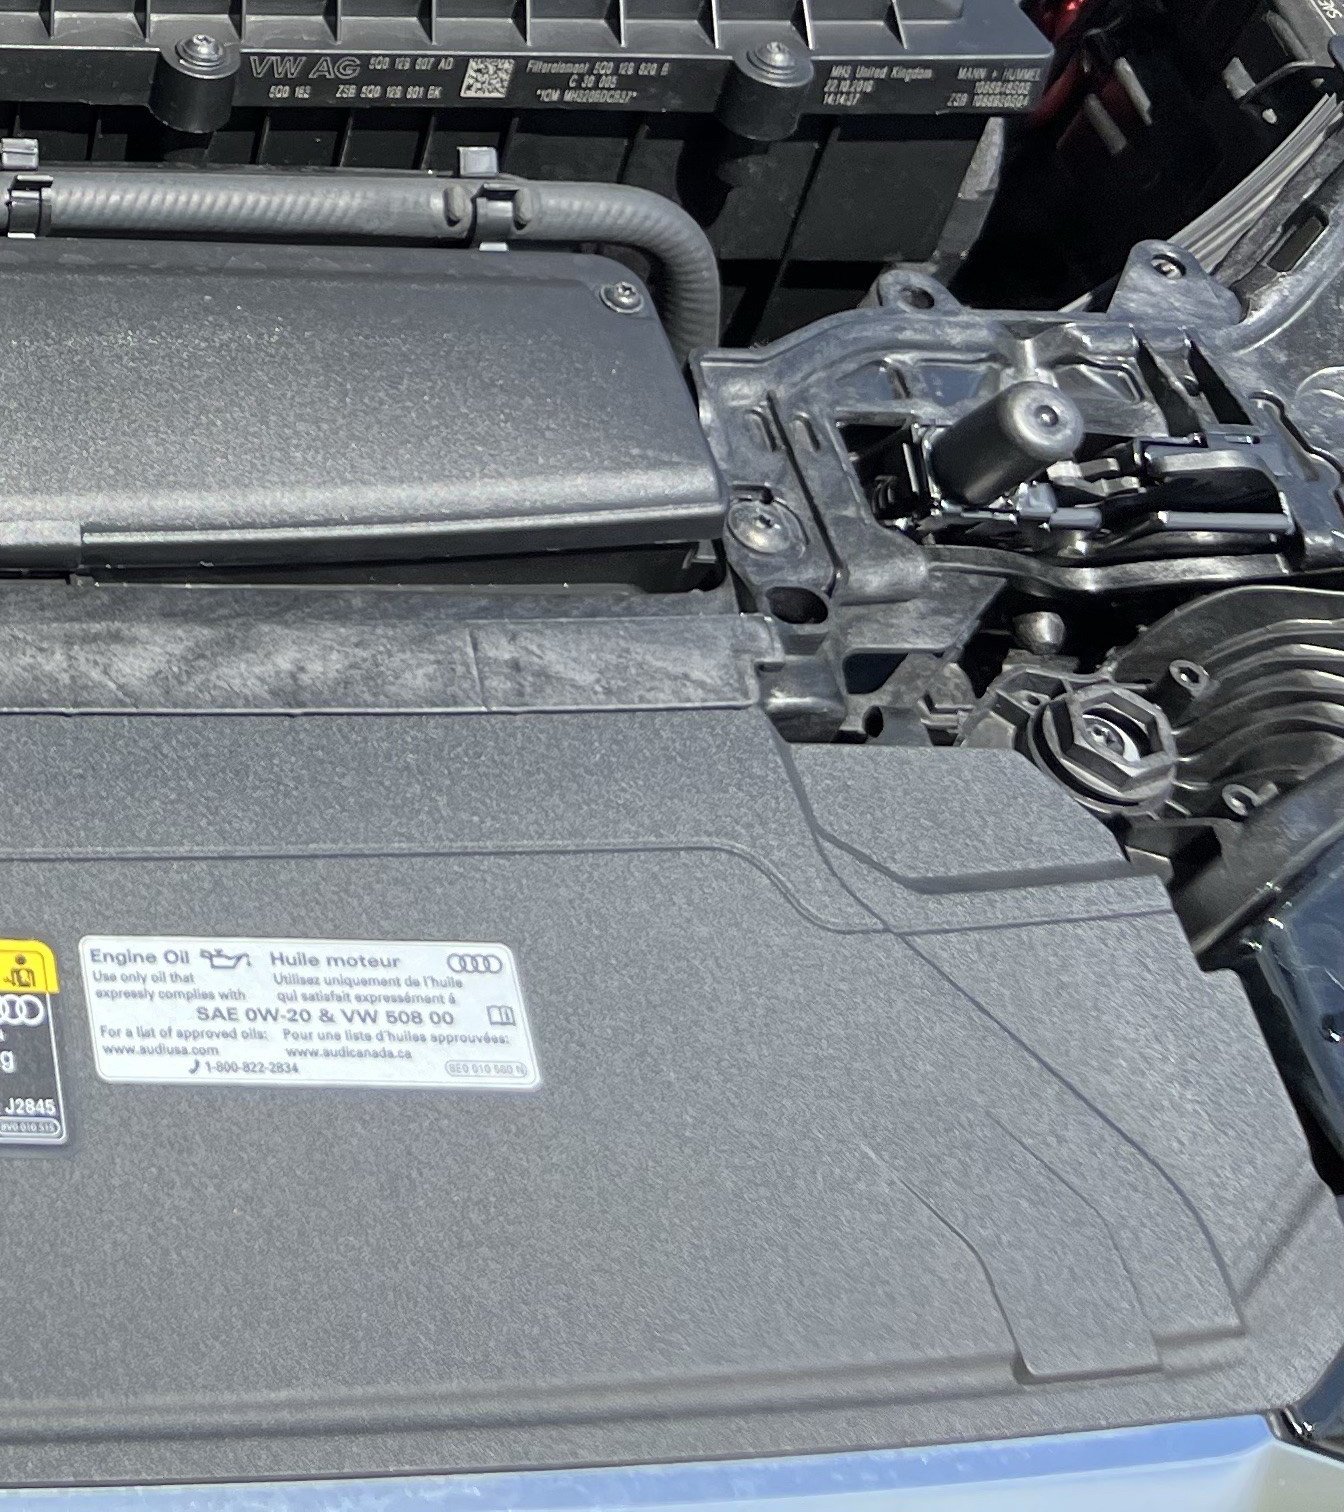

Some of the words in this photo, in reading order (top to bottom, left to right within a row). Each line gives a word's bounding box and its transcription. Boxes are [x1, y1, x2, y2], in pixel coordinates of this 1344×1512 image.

[249, 55, 306, 79] VW
[309, 56, 362, 79] AG
[855, 65, 888, 79] United
[890, 66, 933, 82] Kingdom
[957, 67, 988, 80] MANN
[89, 948, 157, 966] Engine
[164, 949, 190, 964] Oil
[270, 951, 320, 968] Huile
[326, 954, 401, 968] moteur
[92, 970, 116, 982] Use
[120, 971, 146, 985] only
[150, 971, 166, 983] oil
[169, 971, 195, 983] that
[273, 972, 320, 985] Utilisez
[324, 974, 400, 987] uniquement
[404, 975, 421, 988] de
[95, 988, 154, 1001] expressly
[158, 989, 214, 1002] complies
[218, 989, 246, 1000] with
[276, 990, 297, 1003] qui
[301, 990, 351, 1002] satisfait
[196, 1006, 239, 1022] SAE
[245, 1007, 312, 1023] 0W-20
[318, 1009, 335, 1023] &
[340, 1009, 378, 1024] VW
[385, 1010, 423, 1025] 508
[429, 1011, 454, 1025] 00
[100, 1025, 121, 1037] For
[125, 1028, 133, 1038] a
[136, 1026, 155, 1039] list
[159, 1026, 172, 1038] of
[176, 1028, 237, 1040] approved
[282, 1028, 312, 1040] Pour
[317, 1031, 340, 1041] une
[344, 1029, 372, 1041] liste
[102, 1043, 220, 1057] www.audiusa.com
[285, 1045, 413, 1060] www.audicanada.ca
[5, 1097, 56, 1116] J2845
